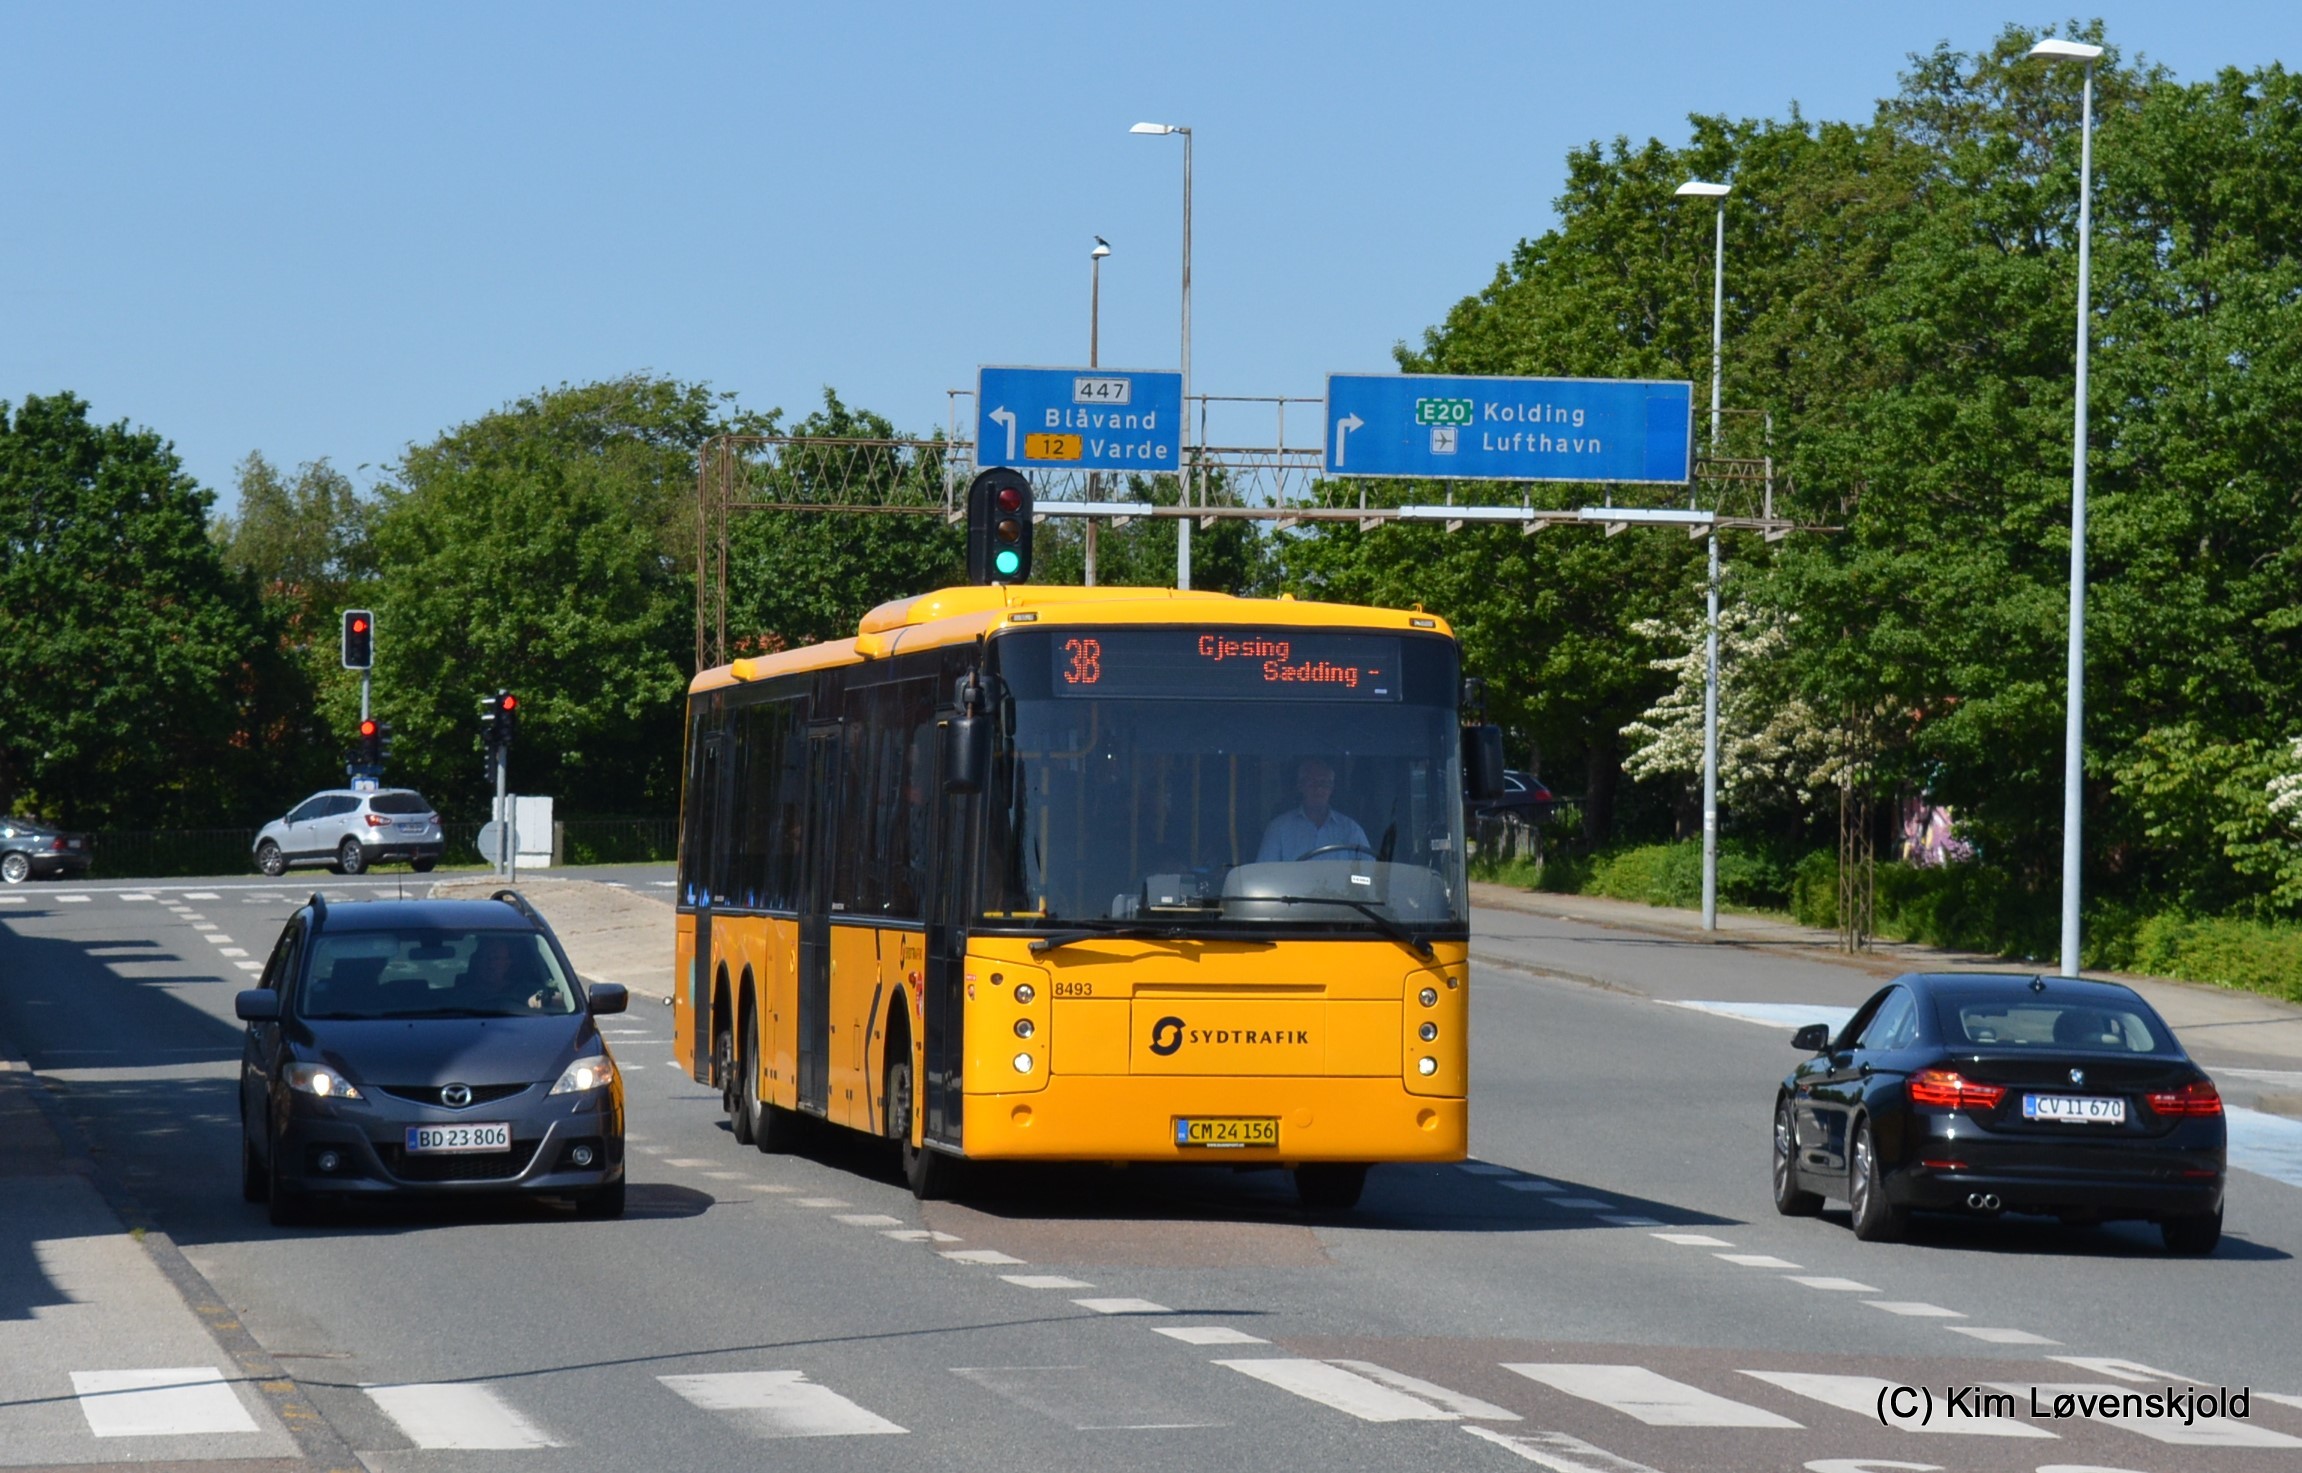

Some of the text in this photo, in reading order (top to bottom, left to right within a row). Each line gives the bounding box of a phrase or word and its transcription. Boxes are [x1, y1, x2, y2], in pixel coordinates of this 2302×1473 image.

[1080, 383, 1124, 398] 447
[1045, 408, 1156, 429] Blåvand
[1424, 402, 1585, 428] E20 Kolding
[1043, 439, 1168, 459] 12 Varde
[1483, 432, 1601, 453] Lufthavn
[1198, 635, 1290, 662] Gjesing
[1064, 639, 1100, 683] 3B
[1263, 660, 1358, 687] Sædding
[1055, 982, 1093, 996] 8493
[1190, 1030, 1309, 1044] SYDTRAFIK
[2037, 1097, 2121, 1117] CV 11 670
[419, 1127, 507, 1147] BD 23 806
[1189, 1123, 1213, 1140] CM
[1216, 1123, 1238, 1140] 24
[1243, 1123, 1274, 1140] 156
